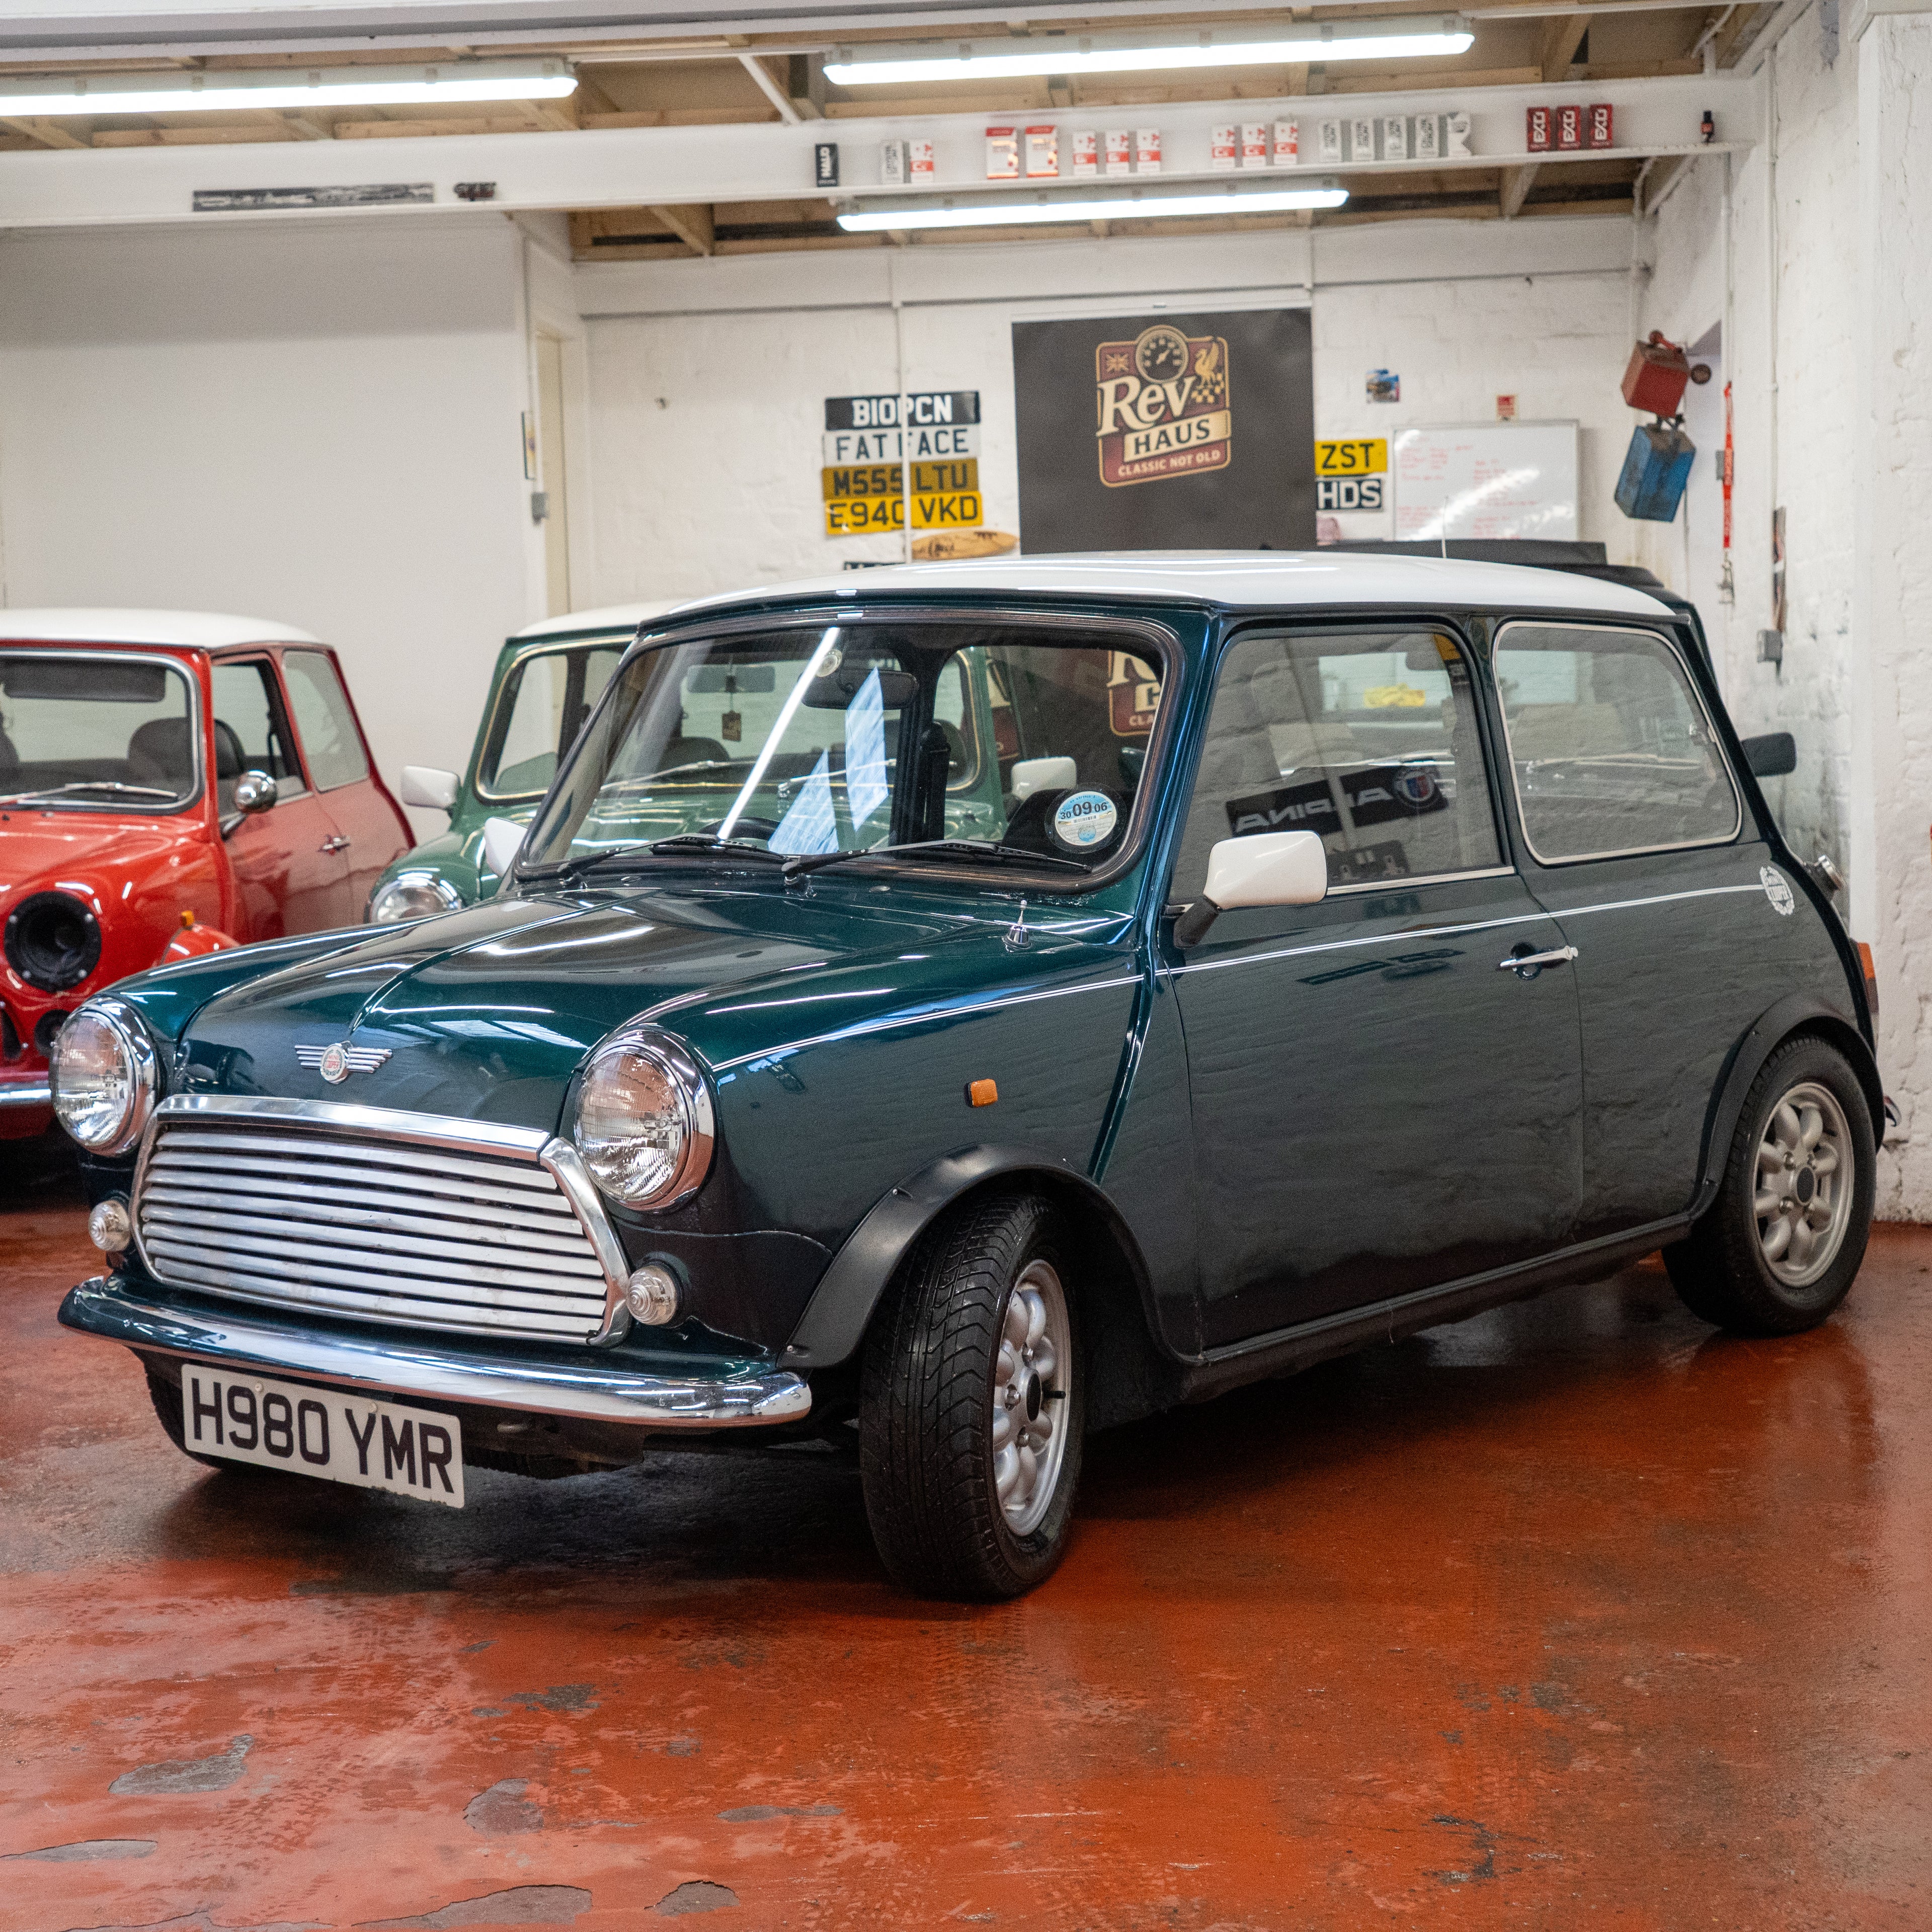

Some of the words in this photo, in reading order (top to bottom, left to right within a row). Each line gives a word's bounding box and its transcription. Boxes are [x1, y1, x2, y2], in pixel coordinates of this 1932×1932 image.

[1096, 375, 1196, 437] Rev
[836, 434, 887, 460] FAT
[1135, 419, 1210, 454] HAUS
[1118, 458, 1166, 477] CLASSIC
[1169, 455, 1193, 467] NOT
[1196, 450, 1221, 462] OLD
[1321, 443, 1374, 469] ZST
[916, 463, 968, 491] LTU
[1318, 480, 1381, 509] HDS
[918, 495, 978, 522] VKD
[1060, 811, 1071, 819] 30
[1072, 801, 1092, 816] 09
[1094, 802, 1107, 812] 06
[191, 1378, 330, 1465] H980
[344, 1408, 454, 1494] YMR
